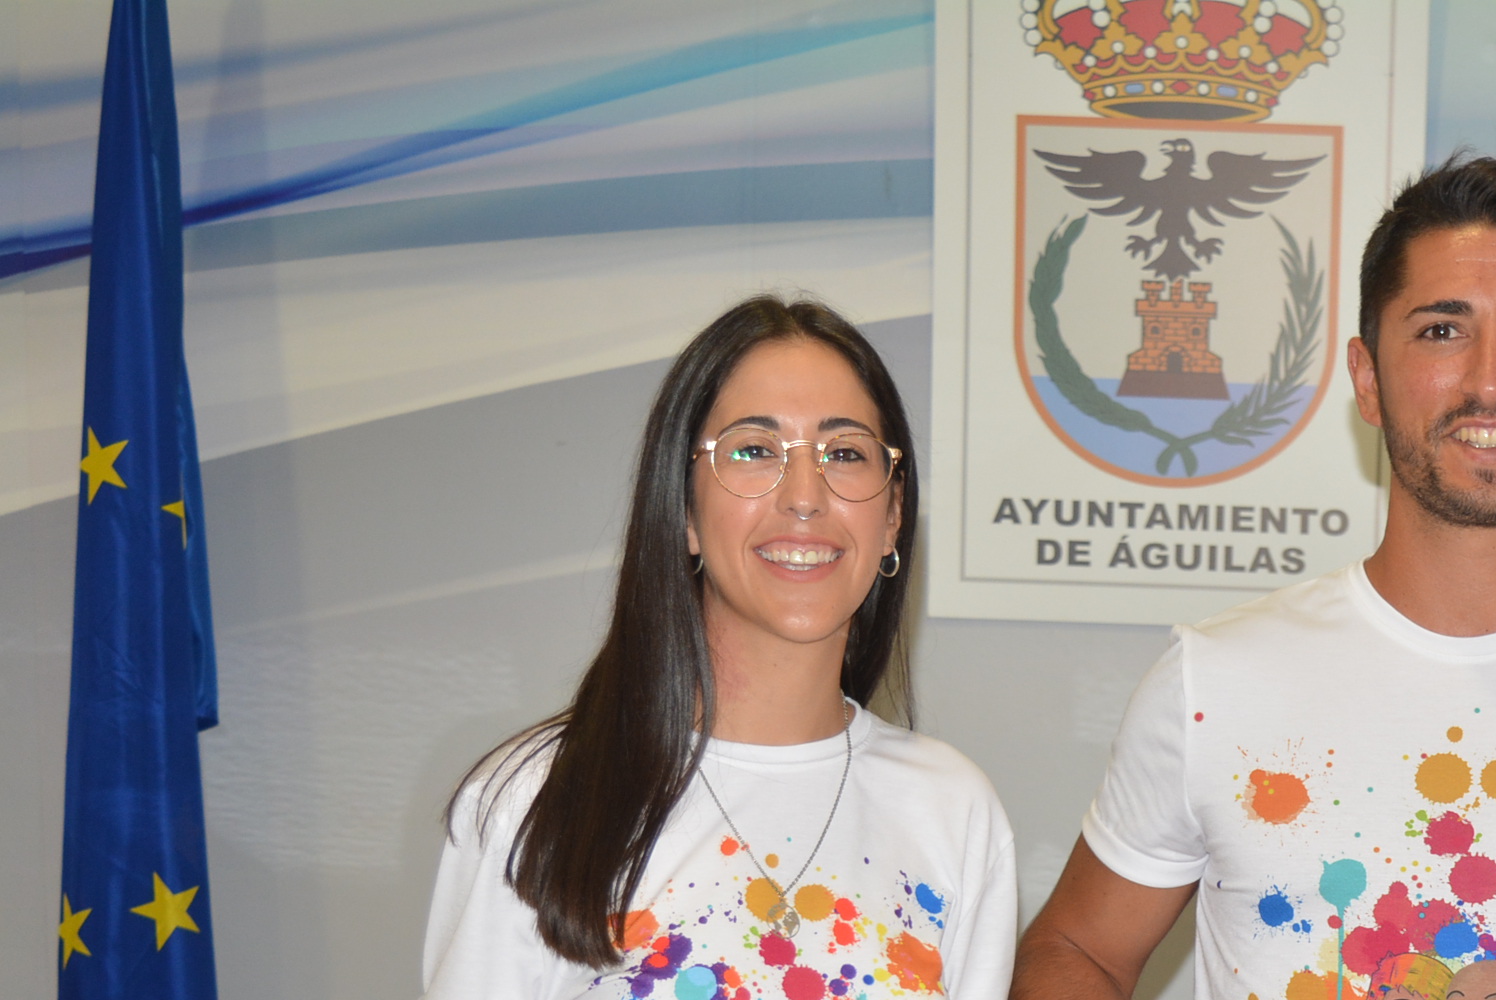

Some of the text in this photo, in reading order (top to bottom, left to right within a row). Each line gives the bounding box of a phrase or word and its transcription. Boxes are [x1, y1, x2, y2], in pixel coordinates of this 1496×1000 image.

[993, 498, 1350, 536] AYUNTAMIENTO
[1035, 535, 1306, 575] DE ÁGUILAS
